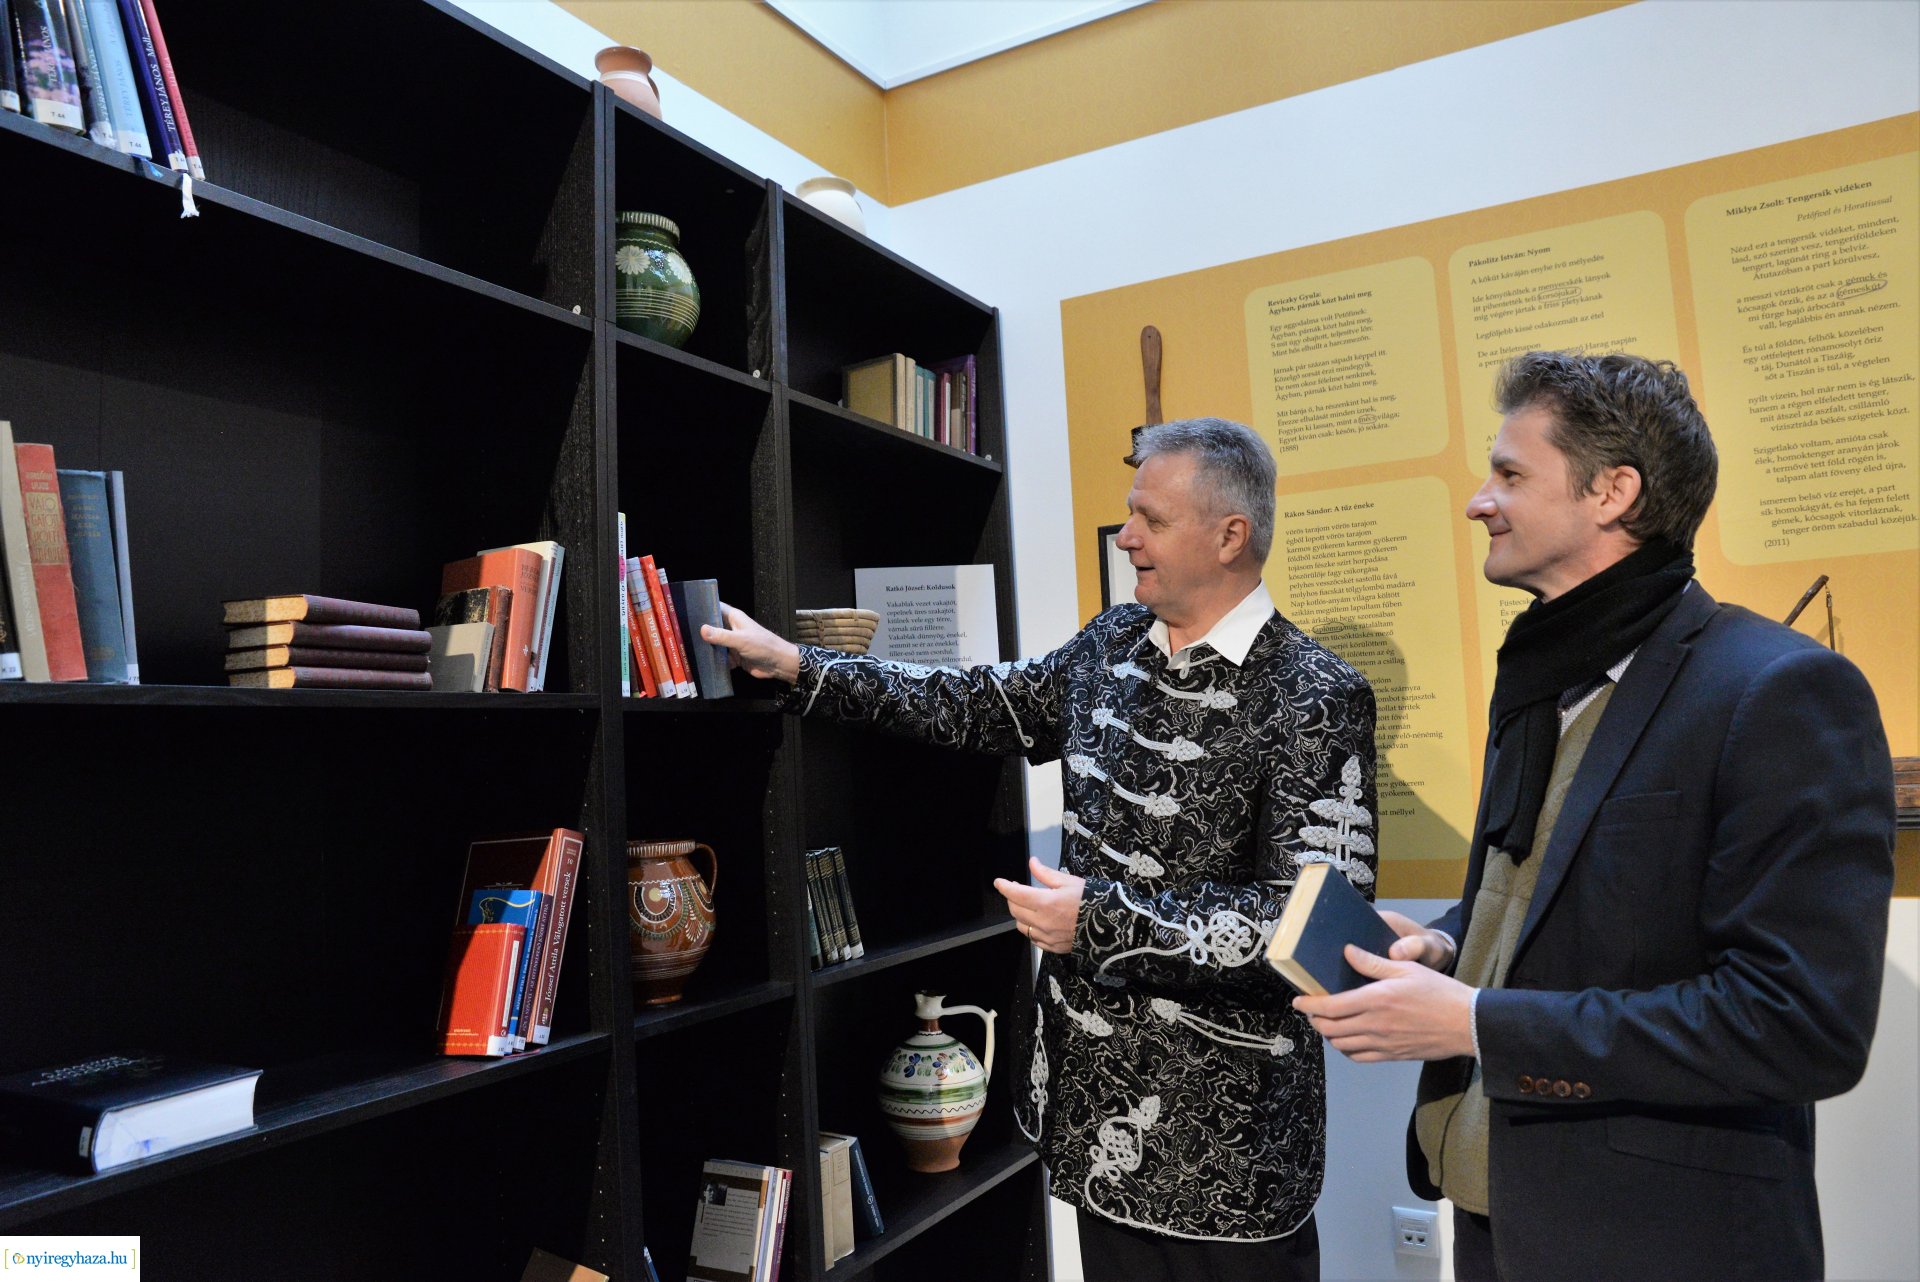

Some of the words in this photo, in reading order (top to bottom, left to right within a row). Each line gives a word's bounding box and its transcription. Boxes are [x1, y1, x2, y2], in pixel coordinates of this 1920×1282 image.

[1726, 205, 1757, 216] Miklya
[1759, 199, 1784, 209] Zsolt:
[1787, 188, 1831, 204] Tengersík
[1834, 182, 1872, 194] vidéken
[1797, 208, 1831, 221] Petőfivel
[1843, 196, 1892, 212] Horatiussal
[1730, 243, 1753, 254] Nézd
[1755, 240, 1768, 249] ezt
[1777, 231, 1818, 245] tengersík
[1819, 225, 1855, 237] vidéket,
[1857, 217, 1899, 230] mindent,
[1732, 254, 1751, 264] lásd,
[1753, 250, 1768, 260] szó
[1769, 245, 1799, 257] szerint
[1800, 243, 1823, 251] vesz,
[1743, 261, 1774, 272] tengert,
[1839, 244, 1869, 254] belvíz.
[1753, 266, 1803, 280] Átutazóban
[1812, 260, 1831, 272] part
[1832, 253, 1879, 266] körülvesz,
[1755, 456, 1775, 464] élek,
[1776, 450, 1835, 462] homoktenger
[1837, 444, 1874, 454] aranyán
[1875, 440, 1899, 452] járok
[1776, 474, 1806, 483] talpam
[1808, 471, 1828, 479] alatt
[1863, 464, 1883, 473] éled
[1885, 463, 1906, 472] újra,
[1306, 507, 1332, 515] Sándor:
[1353, 501, 1374, 509] éneke
[1761, 507, 1773, 516] sík
[1859, 498, 1884, 506] fejem
[1886, 494, 1910, 502] felett
[1771, 516, 1802, 527] gémek,
[1804, 511, 1846, 522] kócsagok
[1847, 505, 1902, 517] vitorláznak,
[1782, 527, 1809, 535] tenger
[1811, 523, 1836, 531] öröm
[1837, 518, 1878, 528] szabadul
[1765, 538, 1790, 547] (2011)
[562, 871, 571, 898] versek
[554, 900, 567, 945] Válogatott
[549, 947, 559, 972] Attila
[545, 972, 555, 1002] József
